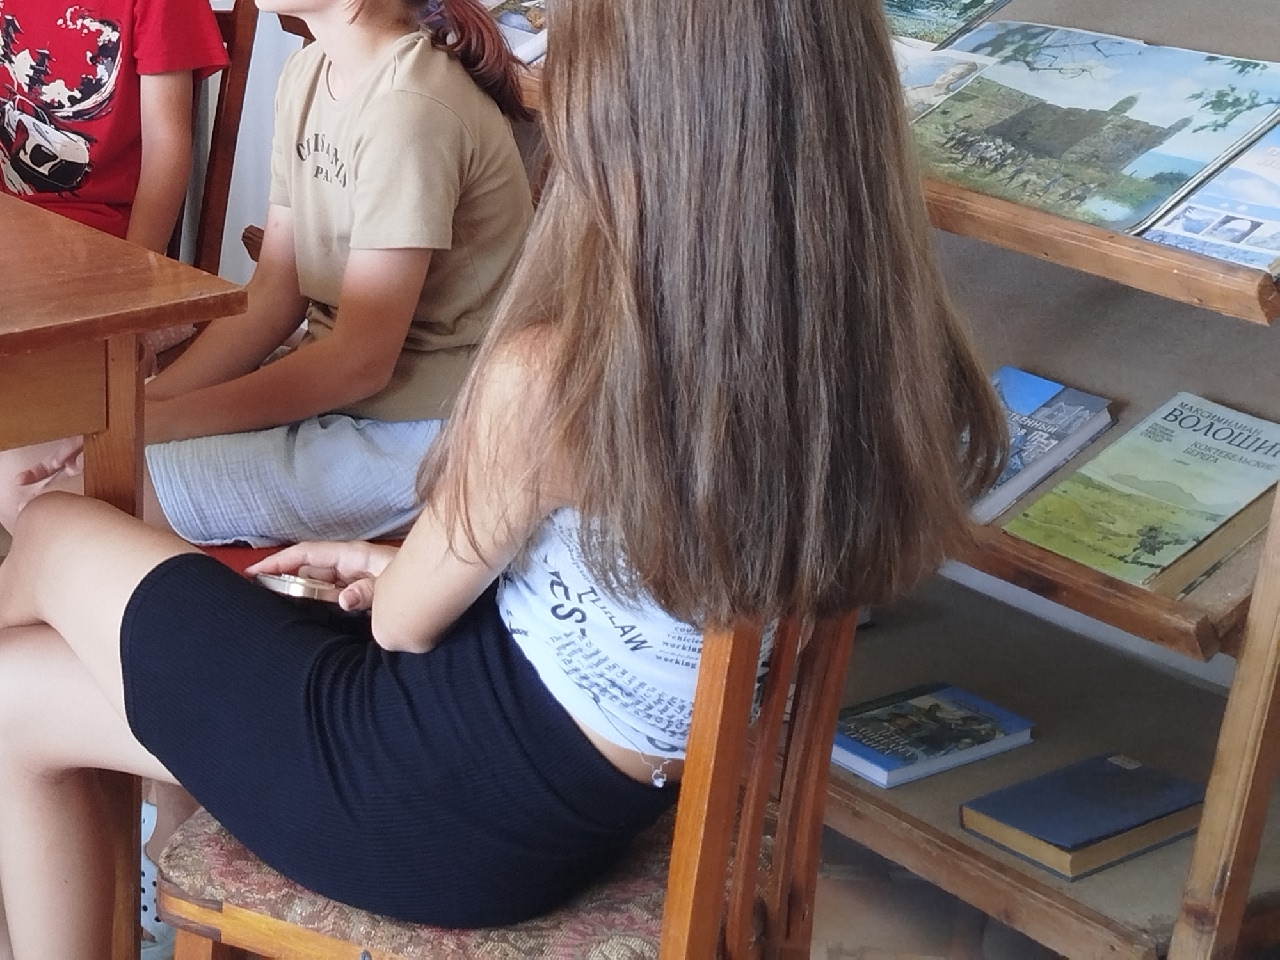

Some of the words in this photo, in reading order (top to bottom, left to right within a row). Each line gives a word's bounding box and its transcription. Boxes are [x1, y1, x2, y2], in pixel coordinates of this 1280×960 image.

[1008, 410, 1060, 434] ТВЕННЫЙ
[1178, 401, 1263, 436] МАКСИМИЛИАН
[1182, 446, 1220, 464] БЕРЕГА
[655, 654, 697, 670] working
